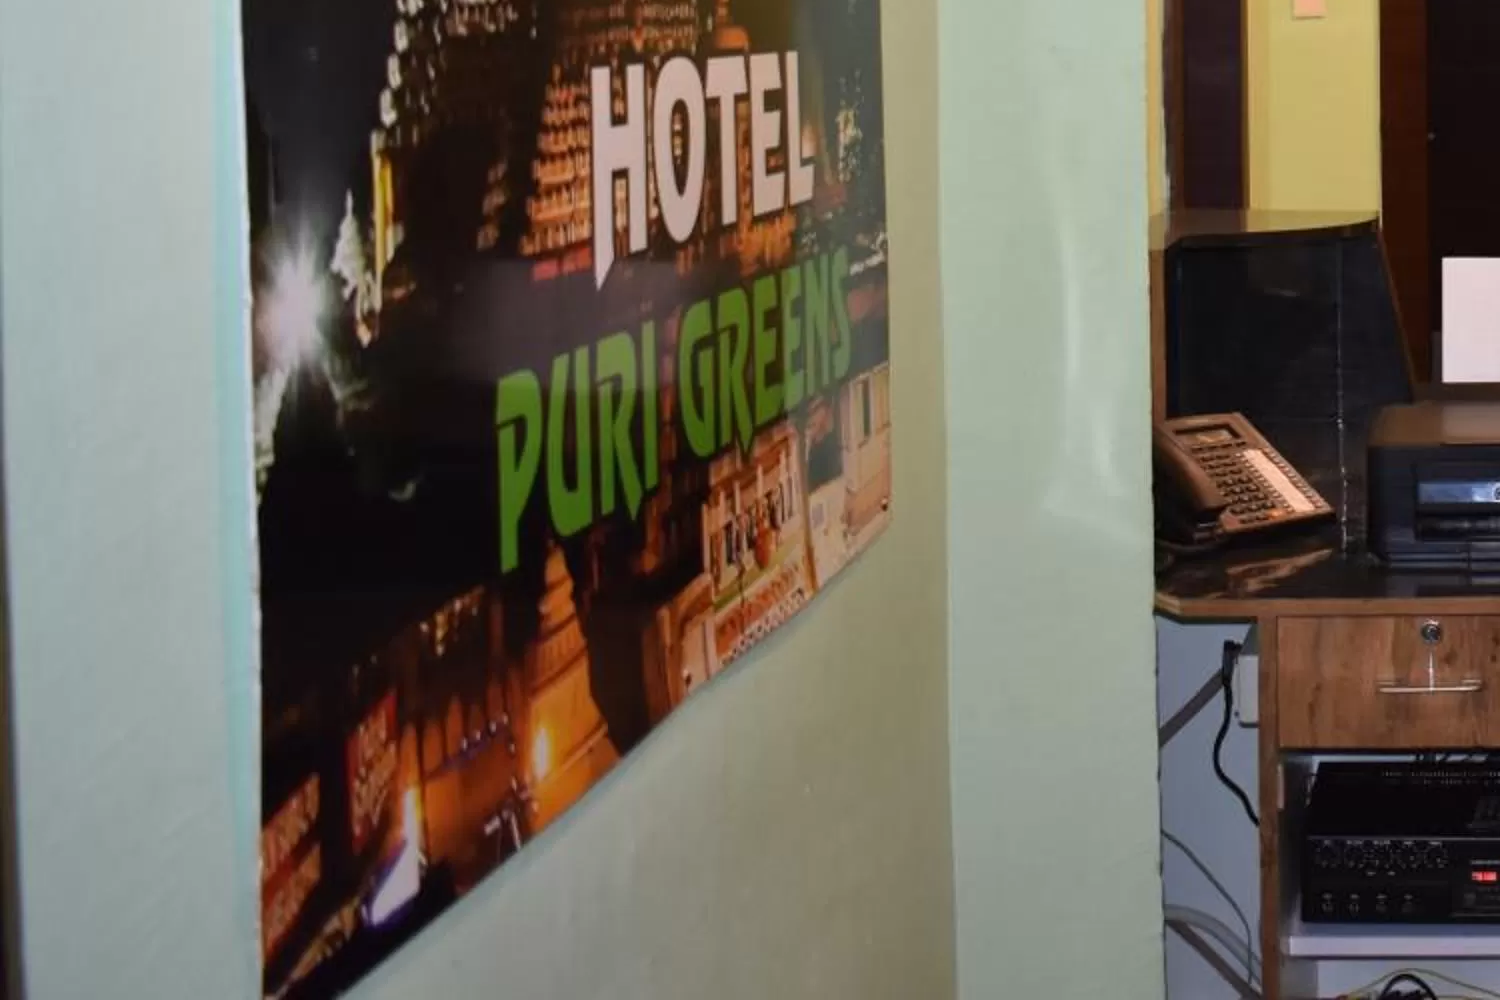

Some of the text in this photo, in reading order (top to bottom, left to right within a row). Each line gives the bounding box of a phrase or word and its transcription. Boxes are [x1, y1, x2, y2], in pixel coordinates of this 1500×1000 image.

[590, 50, 815, 291] HOTEL
[495, 249, 852, 575] PURI GREENS
